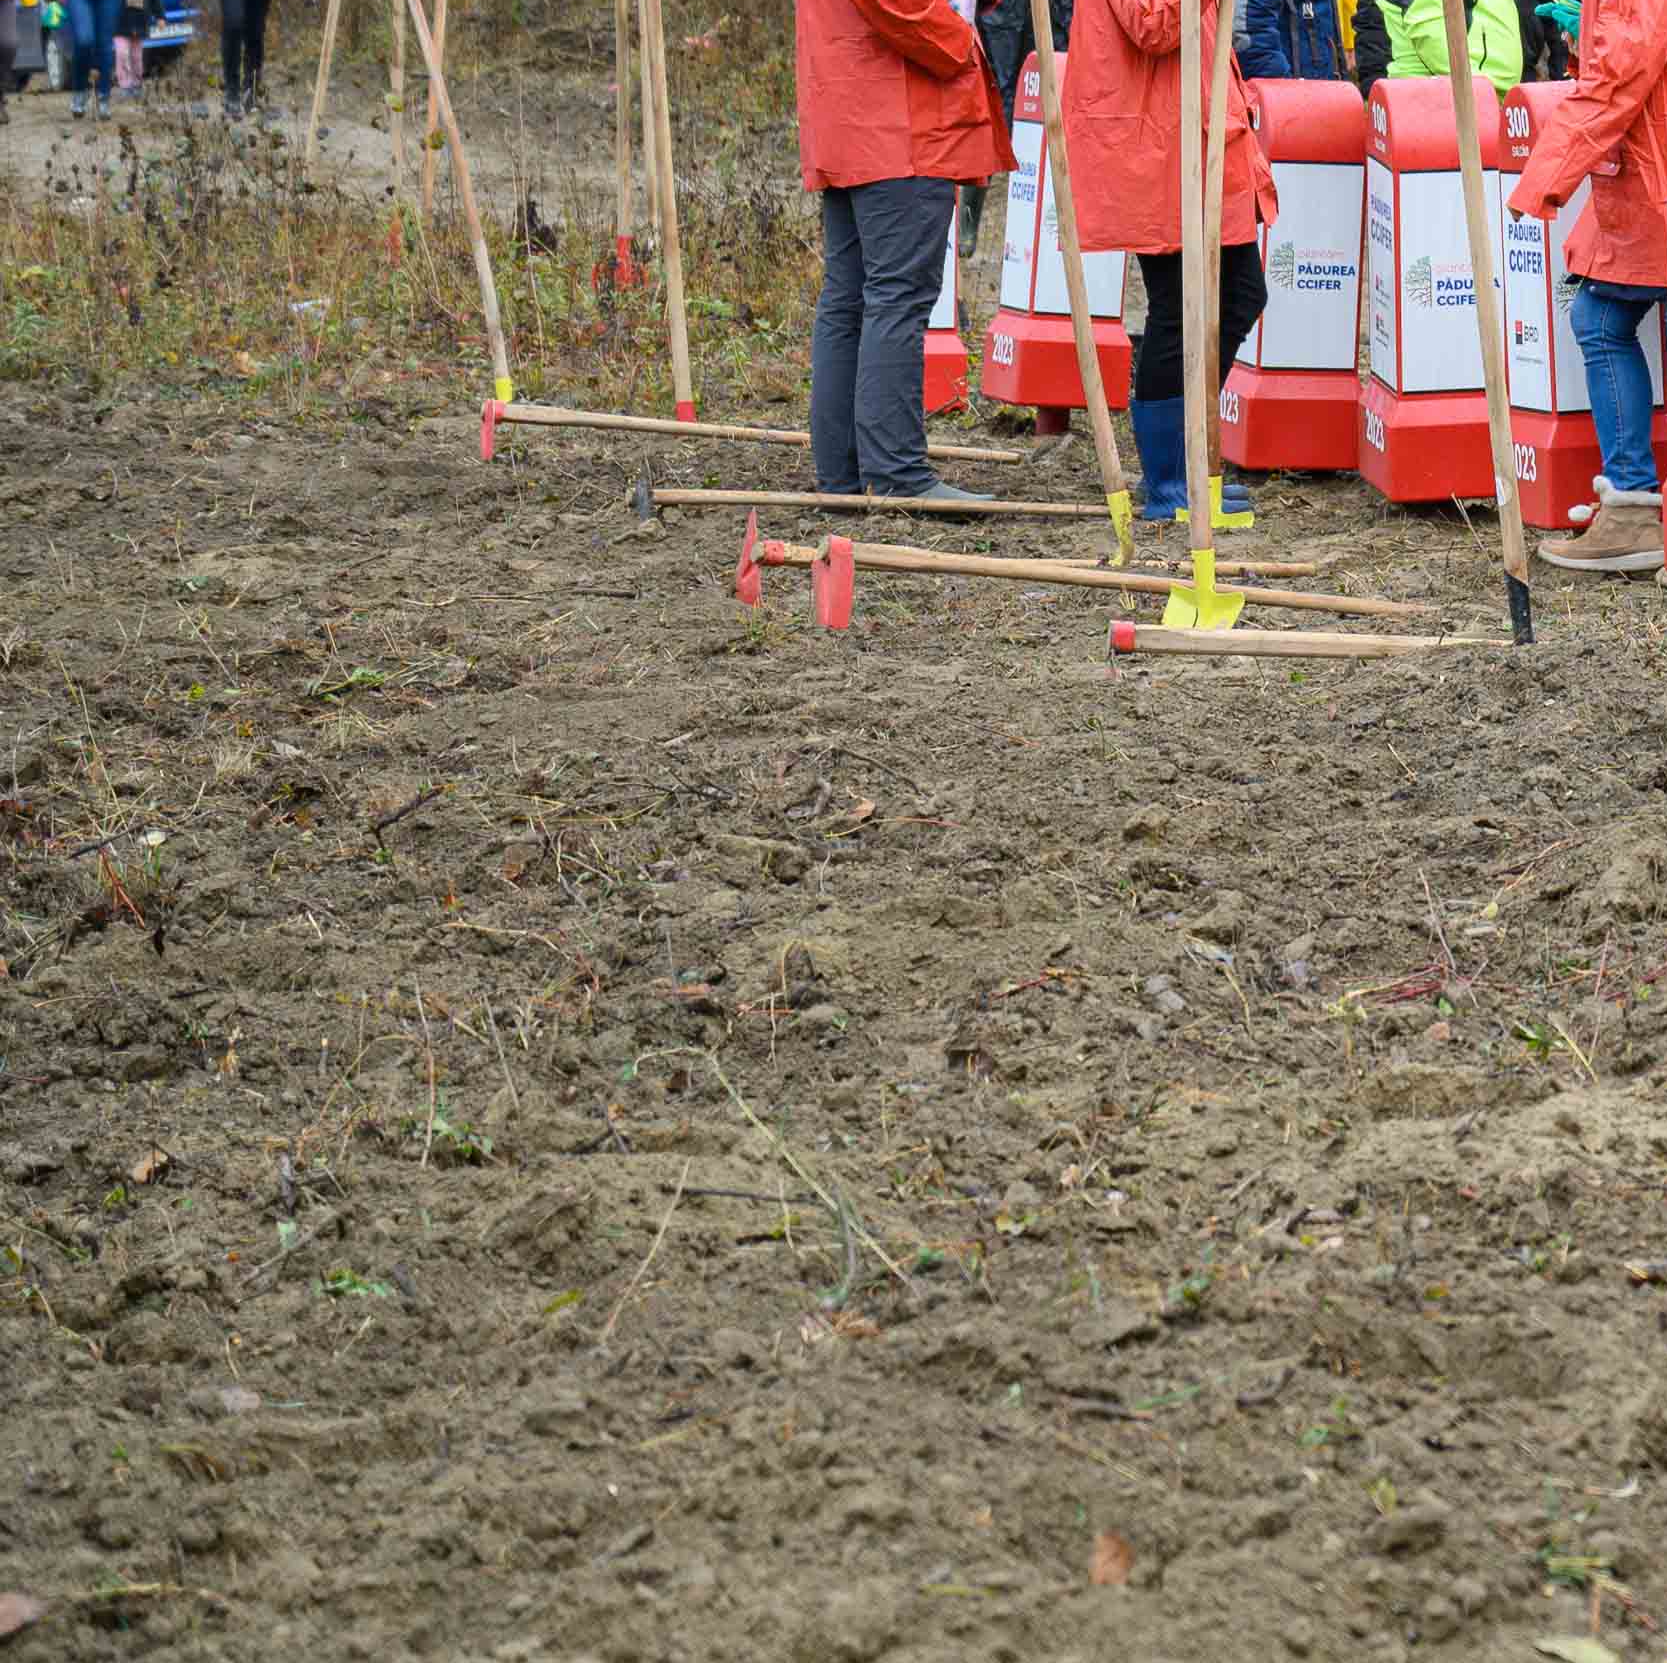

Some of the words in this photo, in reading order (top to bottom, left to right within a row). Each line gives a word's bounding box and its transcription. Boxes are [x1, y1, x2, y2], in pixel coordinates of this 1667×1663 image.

[1023, 72, 1040, 97] 150
[1372, 101, 1387, 135] 100
[1505, 106, 1530, 138] 300
[1298, 264, 1356, 277] PĂDUREA
[1509, 250, 1543, 274] CCIFER
[1298, 279, 1341, 291] CCIFER
[1437, 277, 1501, 292] PĂDUA
[1437, 293, 1476, 306] CCIFE
[992, 334, 1014, 366] 2023
[1219, 390, 1239, 423] 023
[1365, 410, 1385, 452] 2023
[1514, 442, 1537, 483] 023
